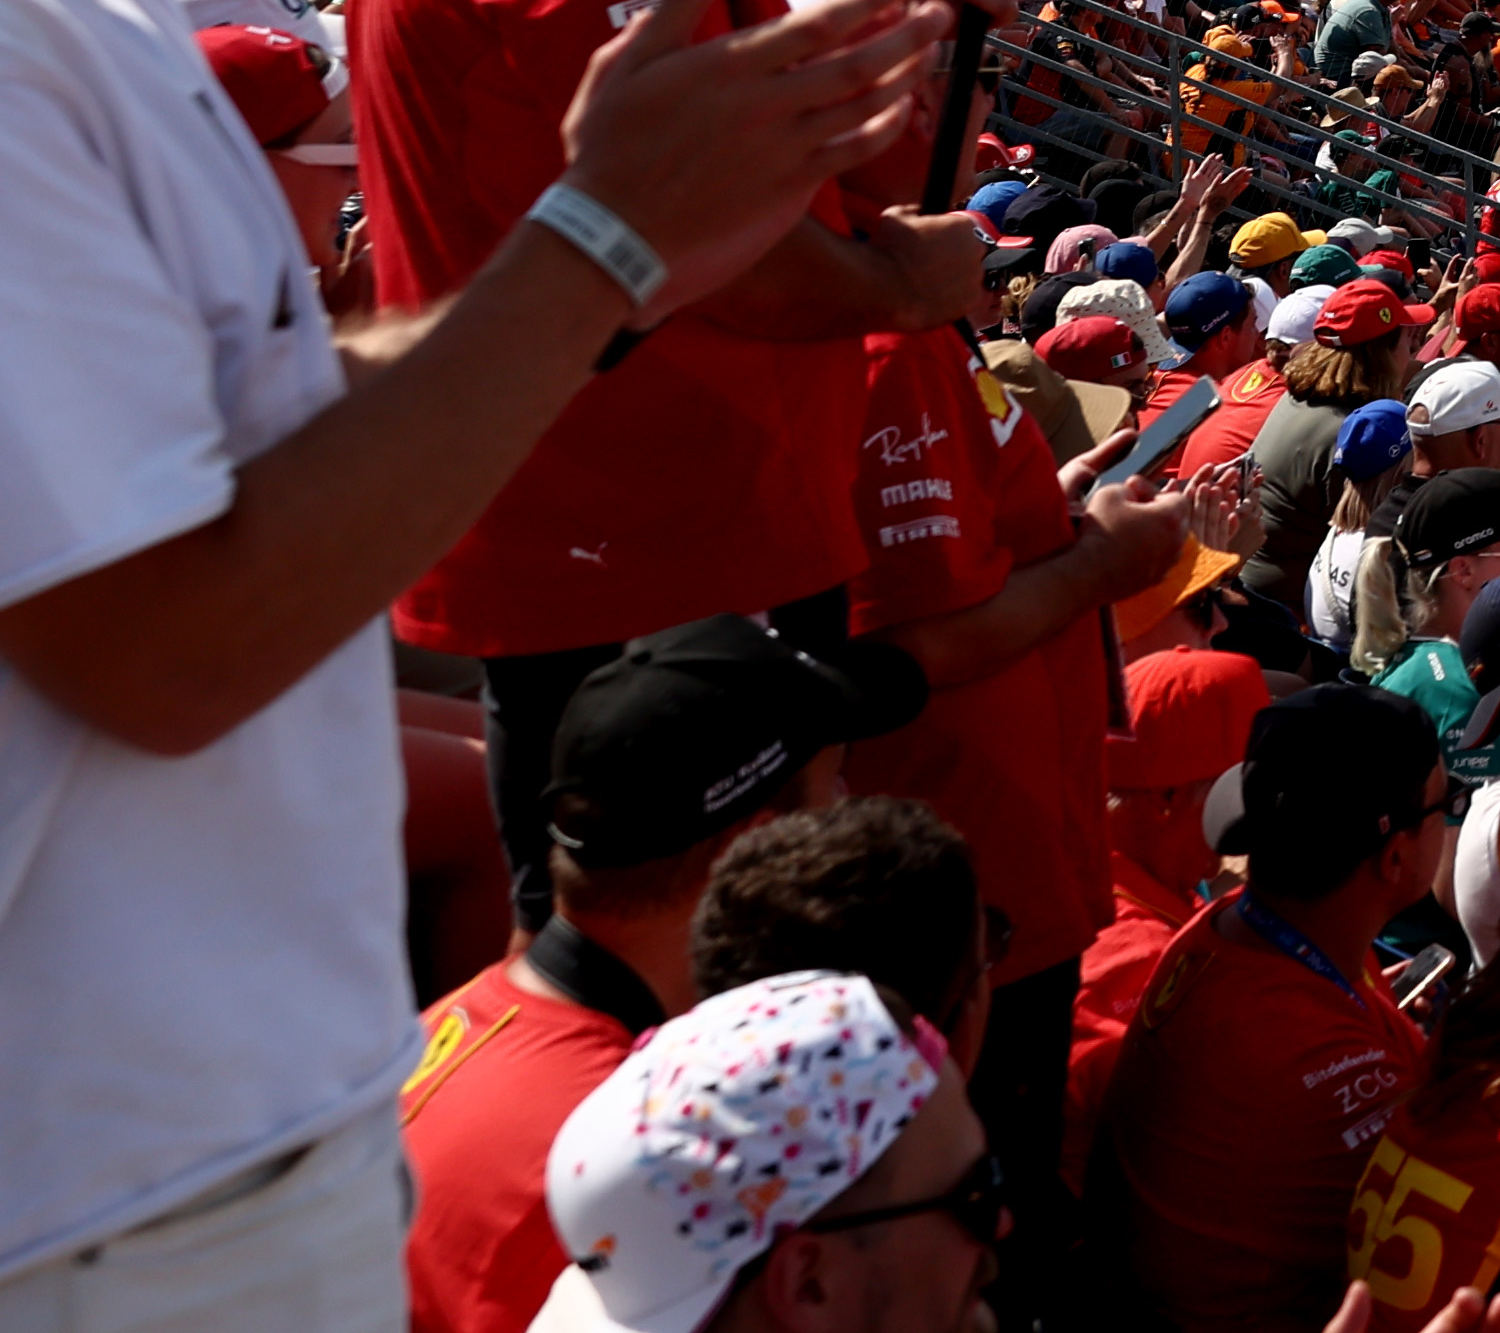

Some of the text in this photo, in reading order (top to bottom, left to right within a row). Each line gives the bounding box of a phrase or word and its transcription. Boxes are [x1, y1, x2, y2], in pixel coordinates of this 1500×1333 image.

[863, 412, 949, 467] Ray-Ban
[881, 477, 954, 508] MAHLE
[1453, 528, 1496, 551] aramco
[1427, 652, 1446, 683] aramco
[1302, 1048, 1388, 1091] Bitdefender
[1333, 1067, 1399, 1115] ZCG
[1347, 1135, 1475, 1313] 55
